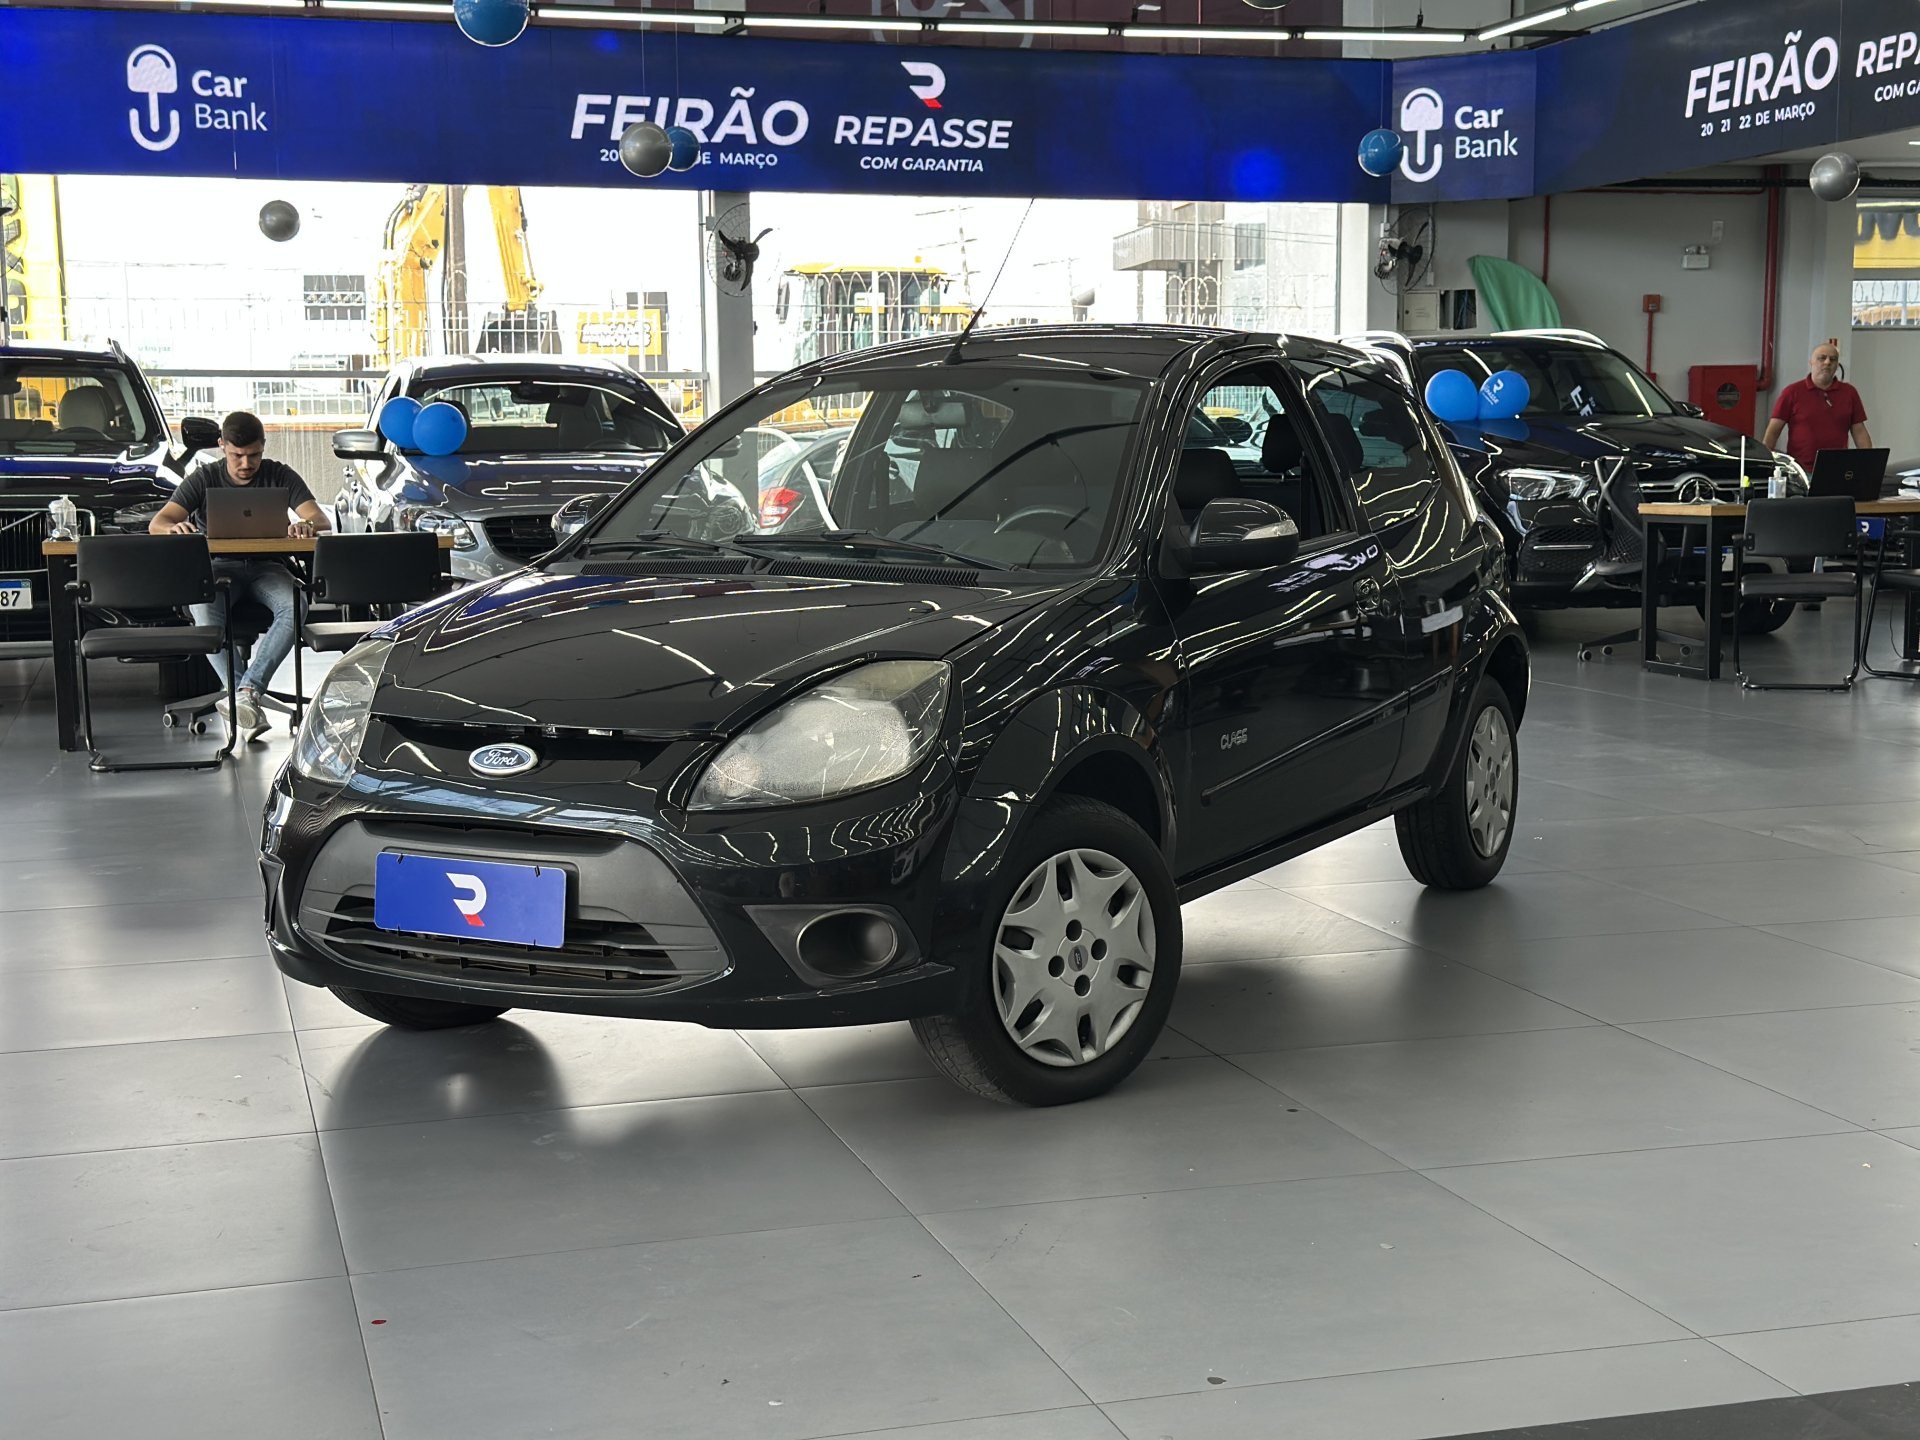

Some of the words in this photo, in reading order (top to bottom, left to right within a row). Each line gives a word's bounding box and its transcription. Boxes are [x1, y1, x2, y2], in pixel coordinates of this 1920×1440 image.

[1855, 31, 1920, 78] REP
[191, 69, 248, 98] Car
[1684, 29, 1839, 119] FEIRÃO
[1874, 82, 1905, 102] COM
[194, 102, 268, 131] Bank
[570, 86, 810, 146] FEIRÃO
[1454, 105, 1504, 131] Car
[1700, 123, 1714, 137] 20
[1720, 119, 1731, 133] 21
[1739, 115, 1752, 130] 22
[1755, 112, 1770, 127] DE
[1775, 101, 1815, 122] MARÇO
[834, 115, 1013, 149] REPASSE
[1454, 132, 1519, 159] Bank
[599, 148, 619, 162] 20
[719, 152, 778, 169] MARÇO
[860, 156, 901, 171] COM
[902, 157, 984, 173] GARANTIA
[483, 748, 520, 767] Ford
